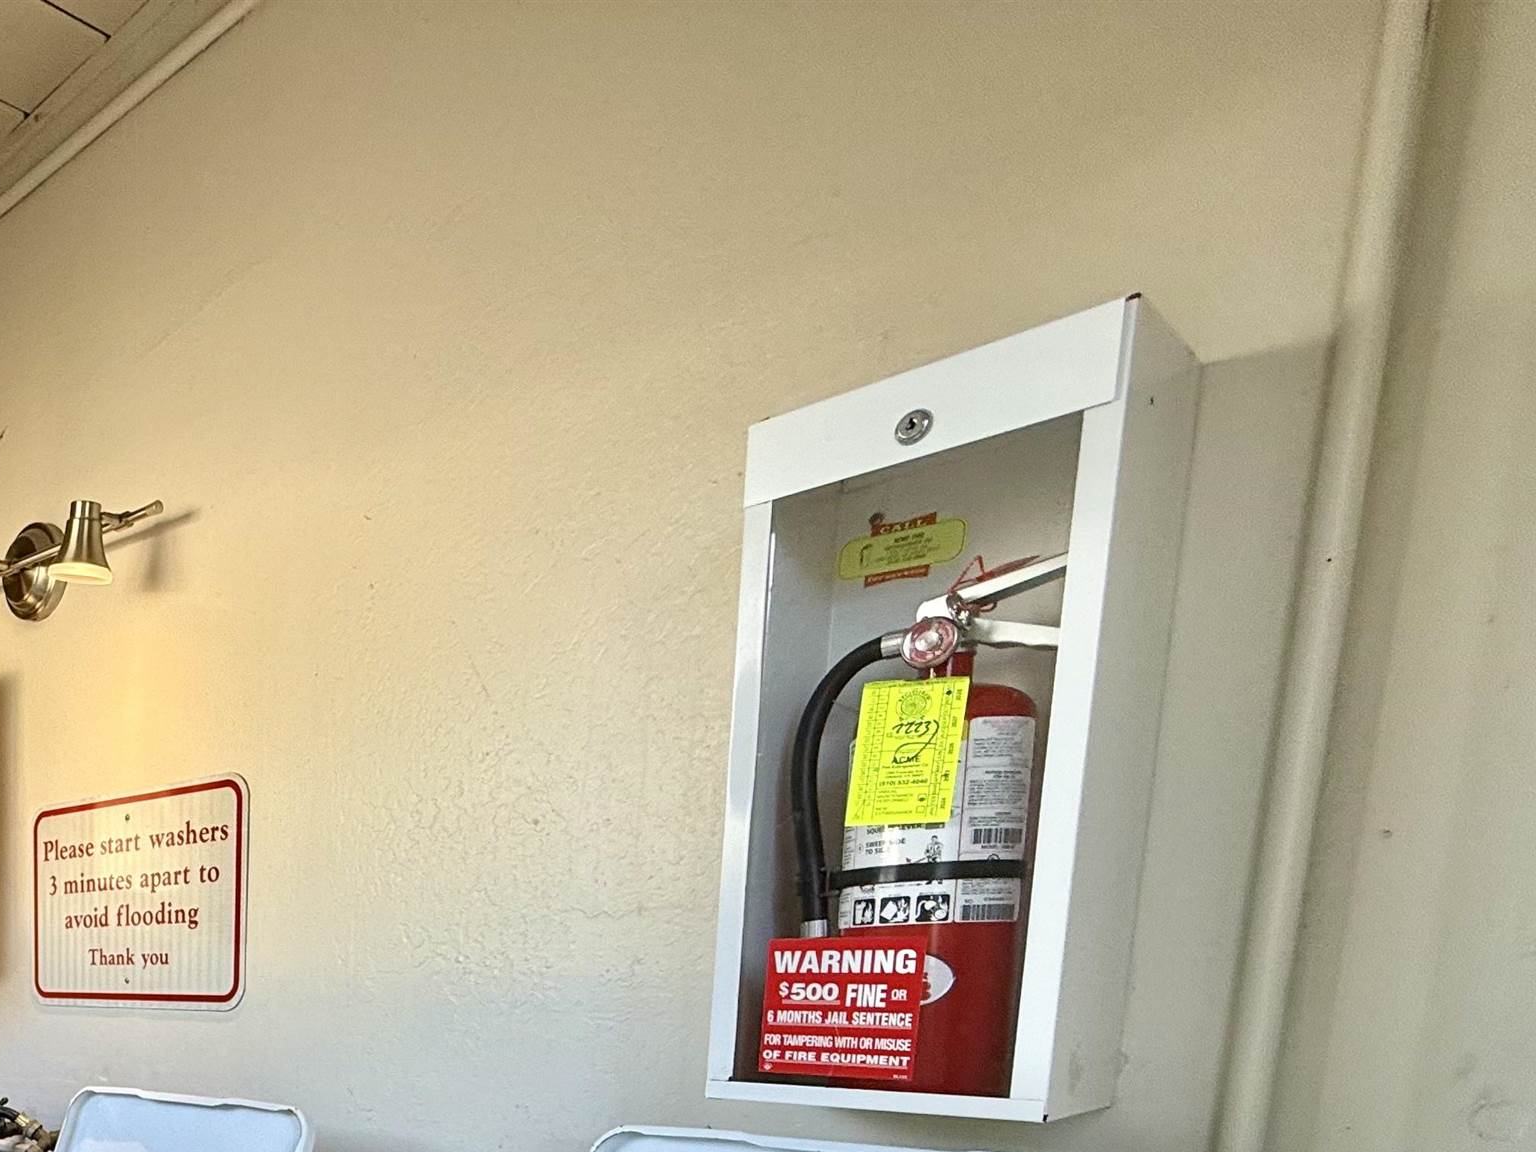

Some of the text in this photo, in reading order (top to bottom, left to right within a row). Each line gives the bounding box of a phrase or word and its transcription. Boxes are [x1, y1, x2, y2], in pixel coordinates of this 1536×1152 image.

[43, 821, 229, 861] Please start washers
[49, 864, 220, 895] 3 minutes apart to
[64, 901, 199, 929] avoid flooding
[88, 948, 169, 969] Thank you
[774, 949, 917, 974] WARNING
[778, 981, 907, 1008] $500 FINE OR
[767, 1010, 913, 1027] 6 MONTHS JAIL SENTENCE
[764, 1033, 911, 1051] FOR TAMPERING WITH OR MISUSE
[762, 1050, 910, 1067] OF FIRE EQUIPMENT
